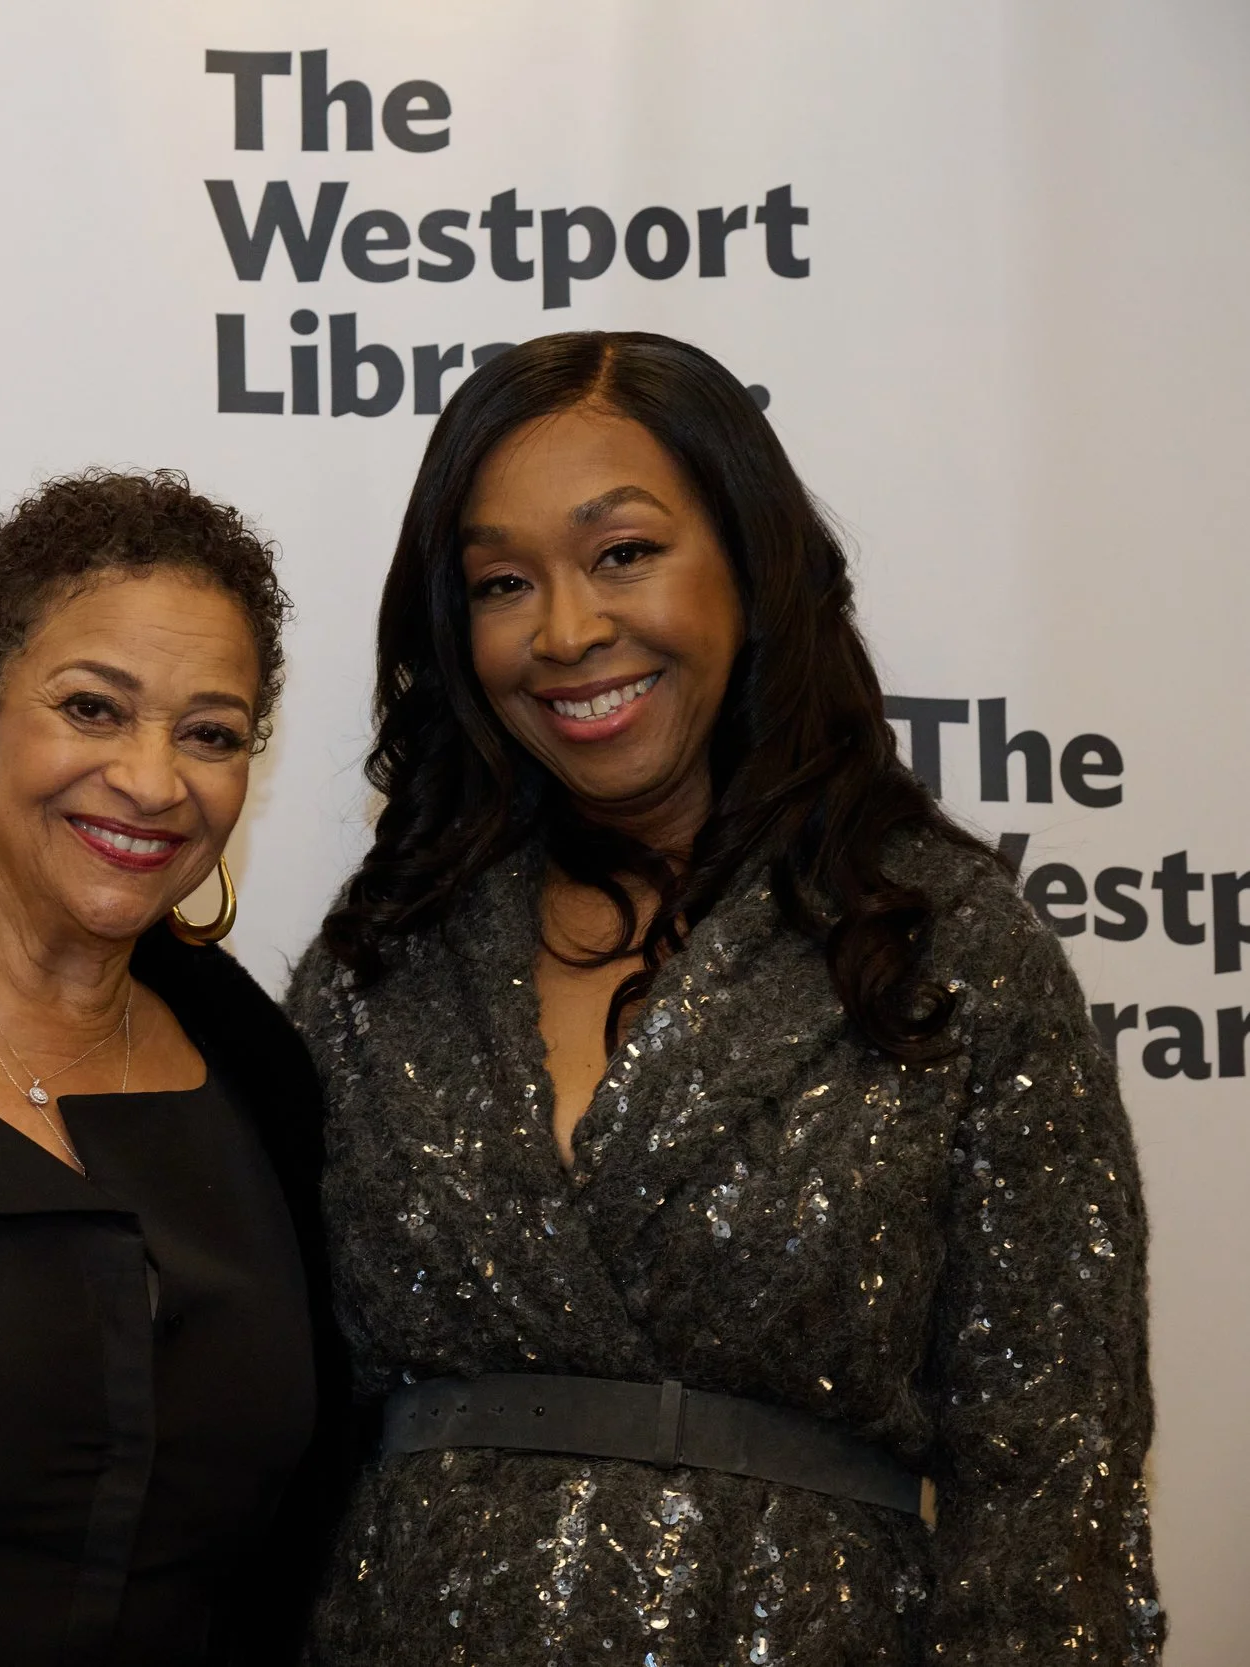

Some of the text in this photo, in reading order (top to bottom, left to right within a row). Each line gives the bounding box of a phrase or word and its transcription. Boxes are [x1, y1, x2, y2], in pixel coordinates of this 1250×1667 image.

[205, 49, 452, 153] The
[204, 180, 810, 310] Westport
[884, 695, 1125, 809] The
[998, 832, 1250, 975] estp
